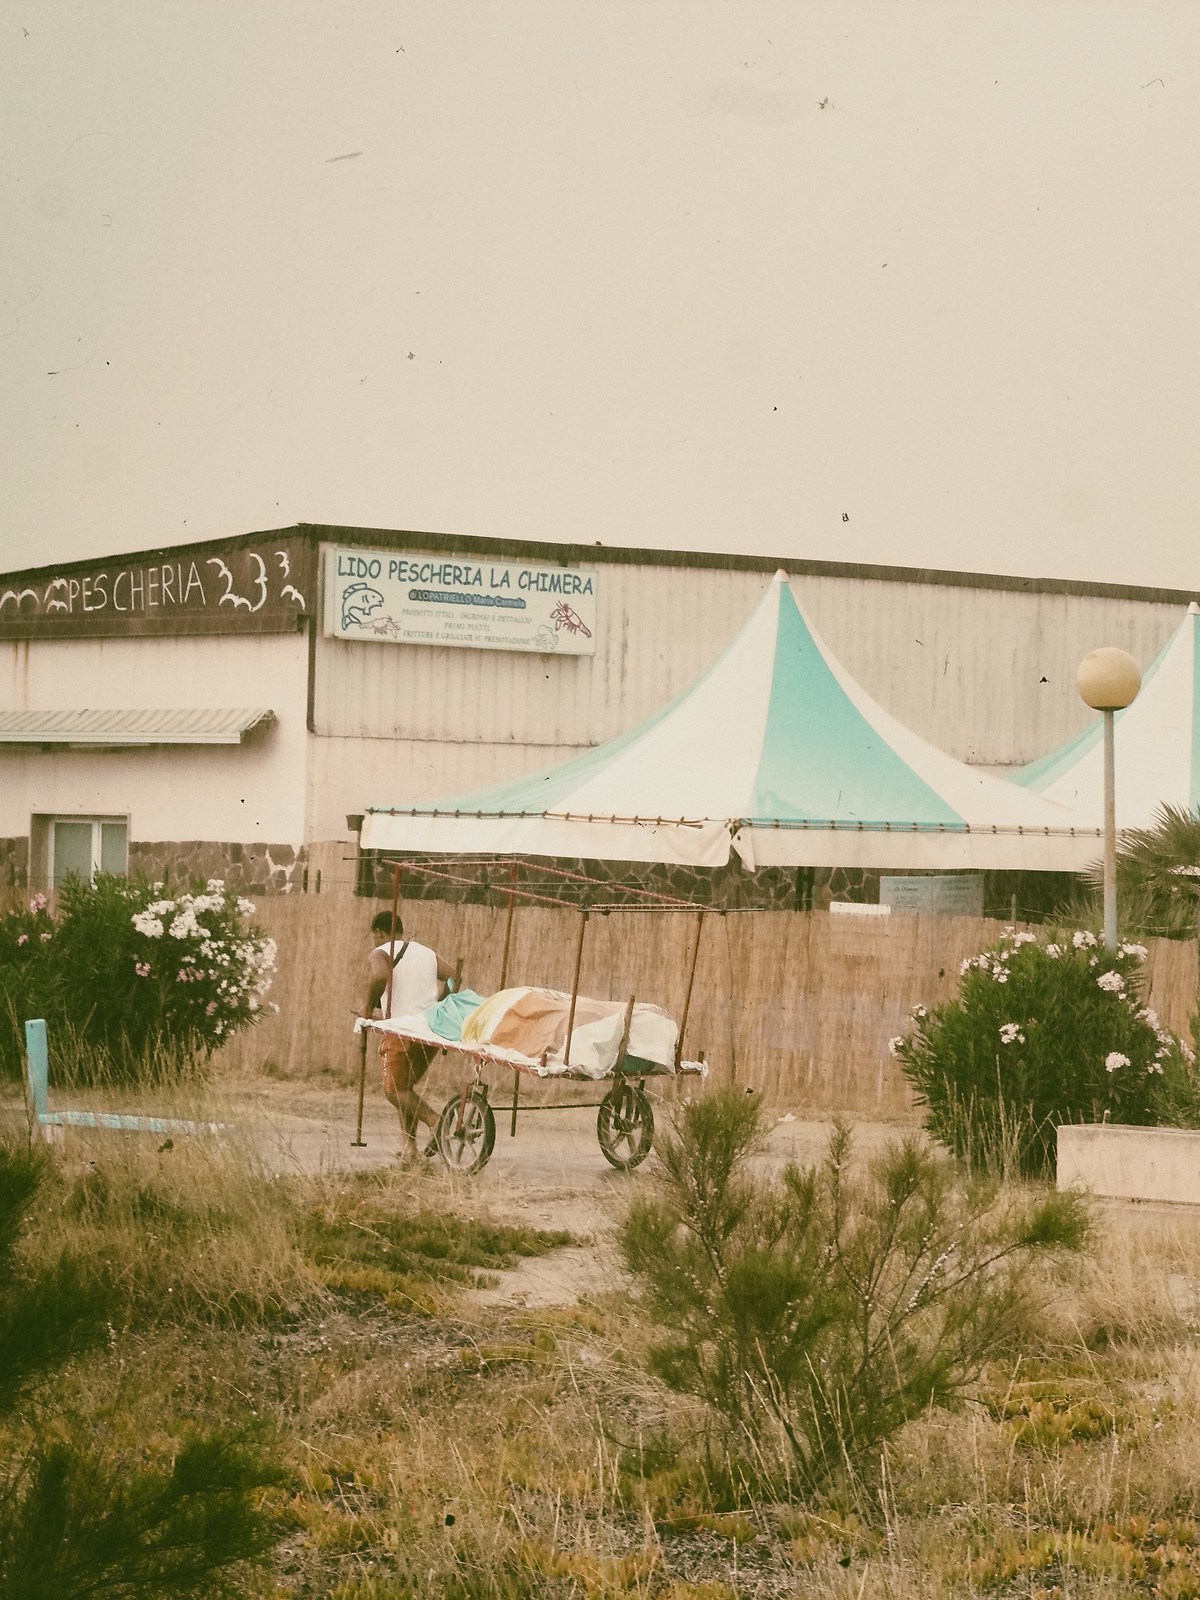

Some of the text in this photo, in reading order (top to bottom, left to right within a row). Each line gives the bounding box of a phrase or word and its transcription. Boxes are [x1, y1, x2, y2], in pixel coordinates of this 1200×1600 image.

[68, 561, 206, 613] PESCHERIA
[337, 556, 594, 596] LIDO PESCHERIA LA CHIMERA
[418, 591, 472, 604] LOPATRIELLO
